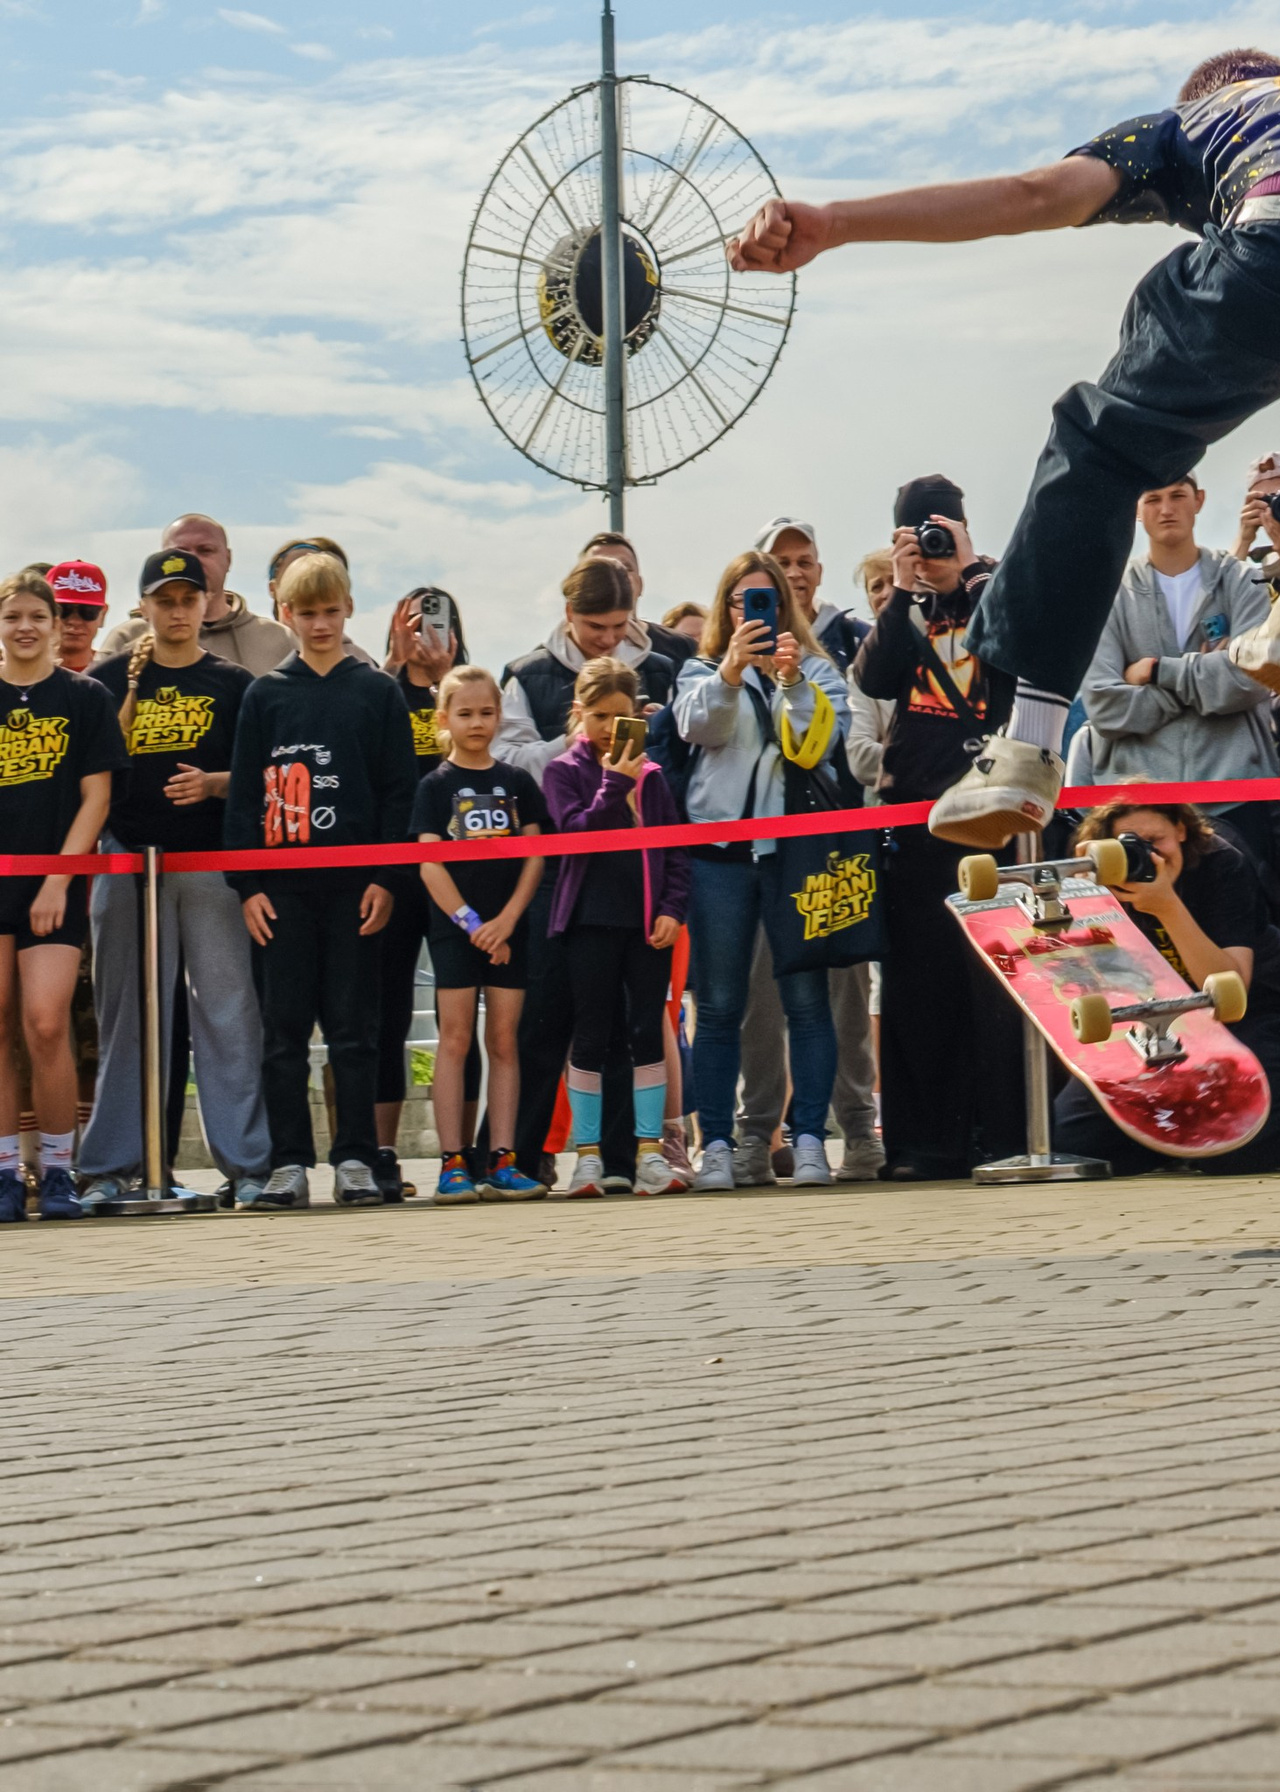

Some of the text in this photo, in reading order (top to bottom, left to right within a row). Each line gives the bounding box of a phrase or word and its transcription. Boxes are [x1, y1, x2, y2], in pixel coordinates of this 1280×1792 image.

[0, 735, 63, 760] RBAN
[131, 726, 198, 749] FEST
[0, 753, 55, 778] EST
[464, 809, 510, 831] 619
